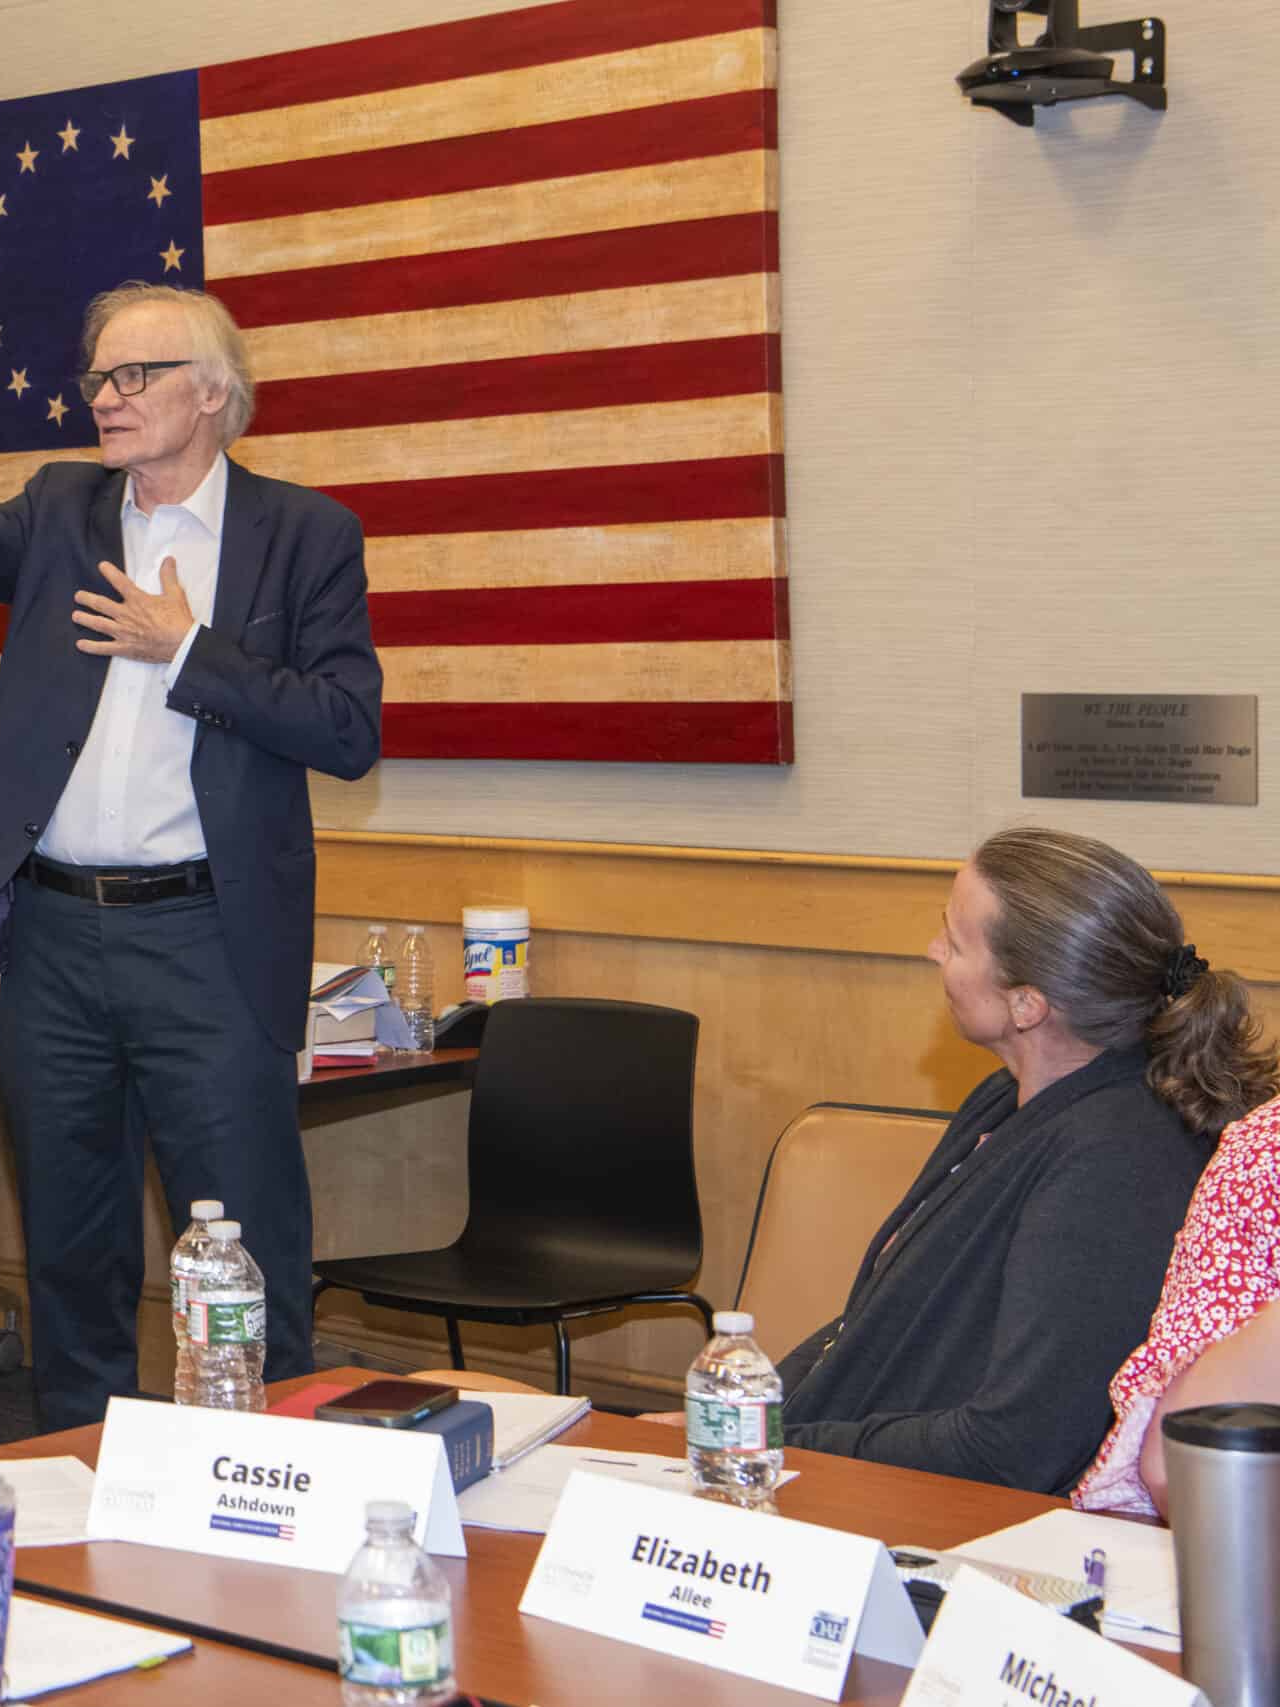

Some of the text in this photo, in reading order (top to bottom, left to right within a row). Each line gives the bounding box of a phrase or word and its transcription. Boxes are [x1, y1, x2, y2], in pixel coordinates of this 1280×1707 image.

[212, 1456, 312, 1493] Cassie
[217, 1493, 296, 1518] Ashdown
[631, 1534, 773, 1594] Elizabeth
[669, 1585, 713, 1609] Allee
